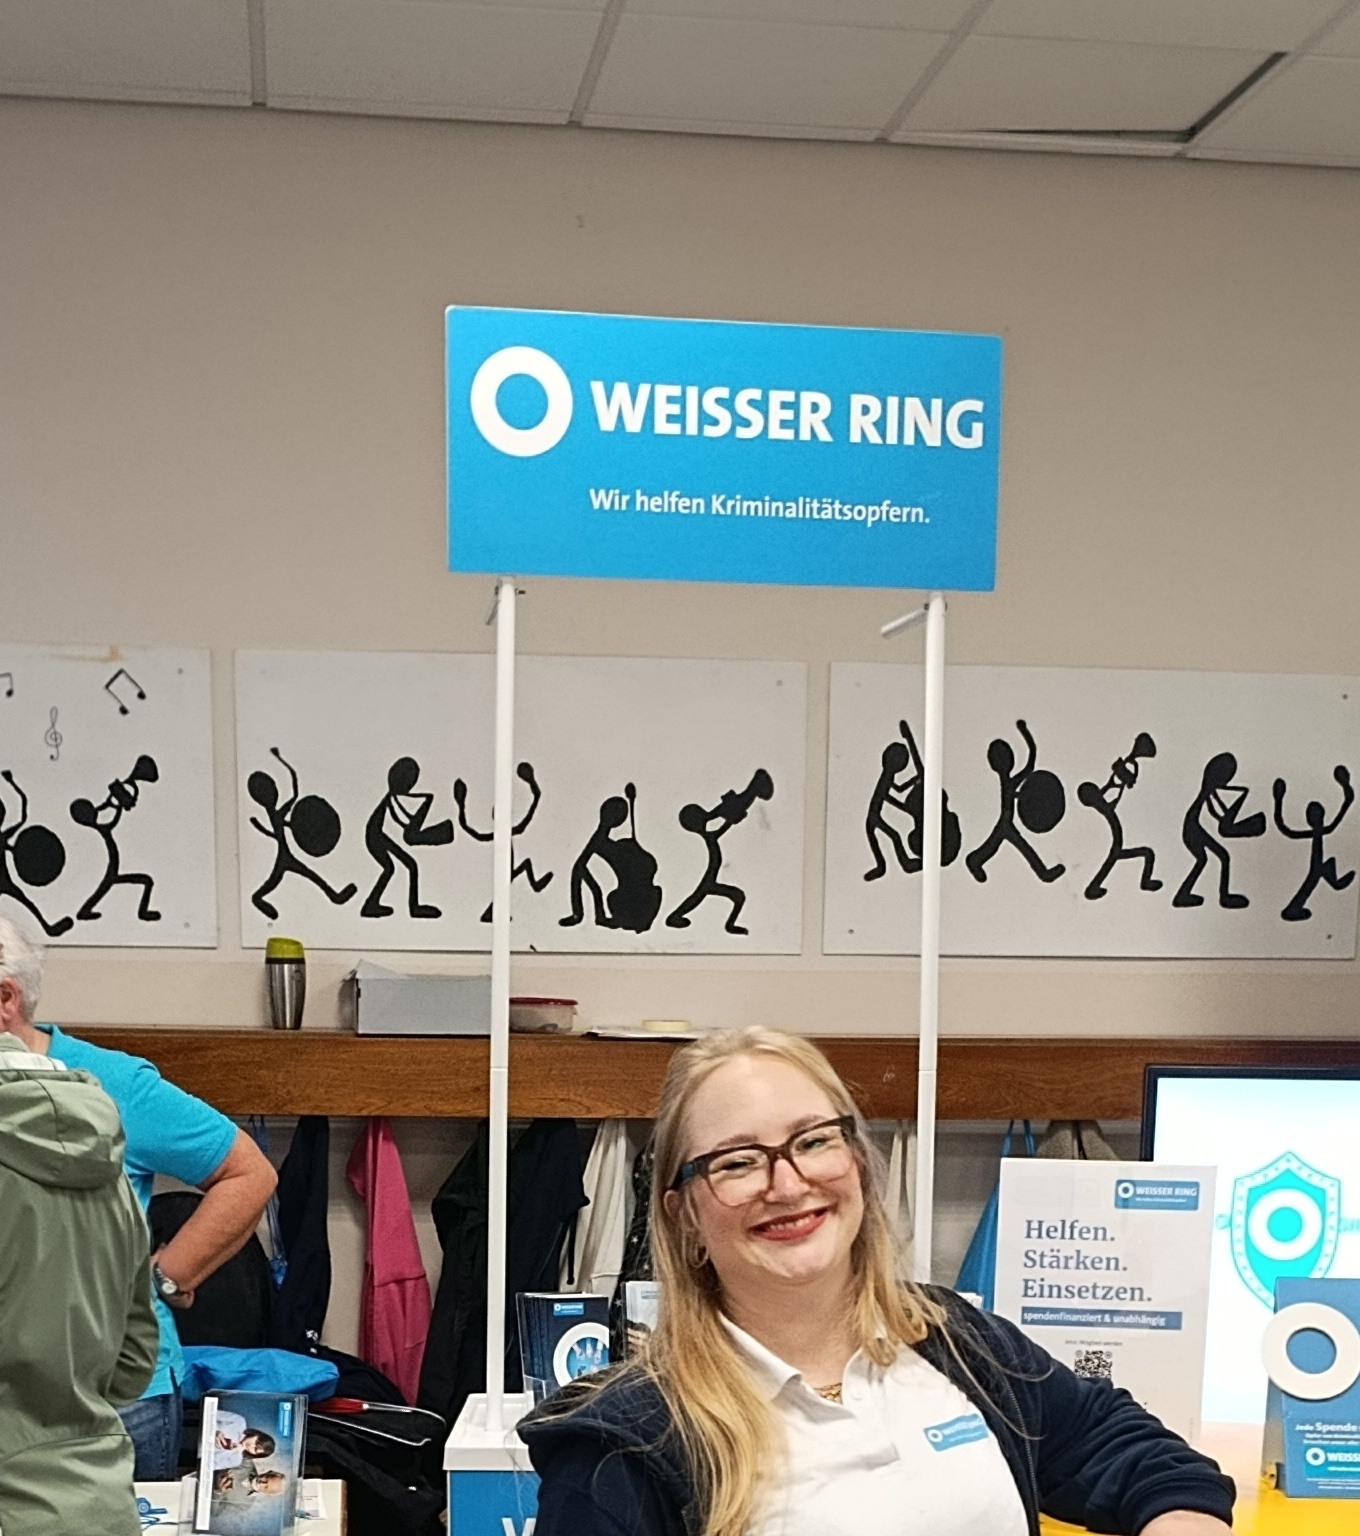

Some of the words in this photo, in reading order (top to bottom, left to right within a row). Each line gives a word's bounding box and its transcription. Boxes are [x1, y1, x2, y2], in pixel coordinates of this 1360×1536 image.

[590, 380, 833, 443] WEISSER
[849, 393, 985, 449] RING
[589, 488, 630, 512] Wir
[635, 490, 705, 515] helfen
[710, 493, 931, 527] Kriminalitätsopfern.
[1136, 1186, 1173, 1196] WEISSER
[1175, 1187, 1197, 1197] RING
[1024, 1219, 1116, 1242] Helfen.
[1023, 1249, 1128, 1272] Stärken.
[1021, 1278, 1153, 1302] Einsetzen.
[1023, 1312, 1102, 1323] spendenfinanziert
[1104, 1314, 1111, 1323] &
[1113, 1314, 1167, 1327] unabhängig
[1315, 1422, 1357, 1433] Spende
